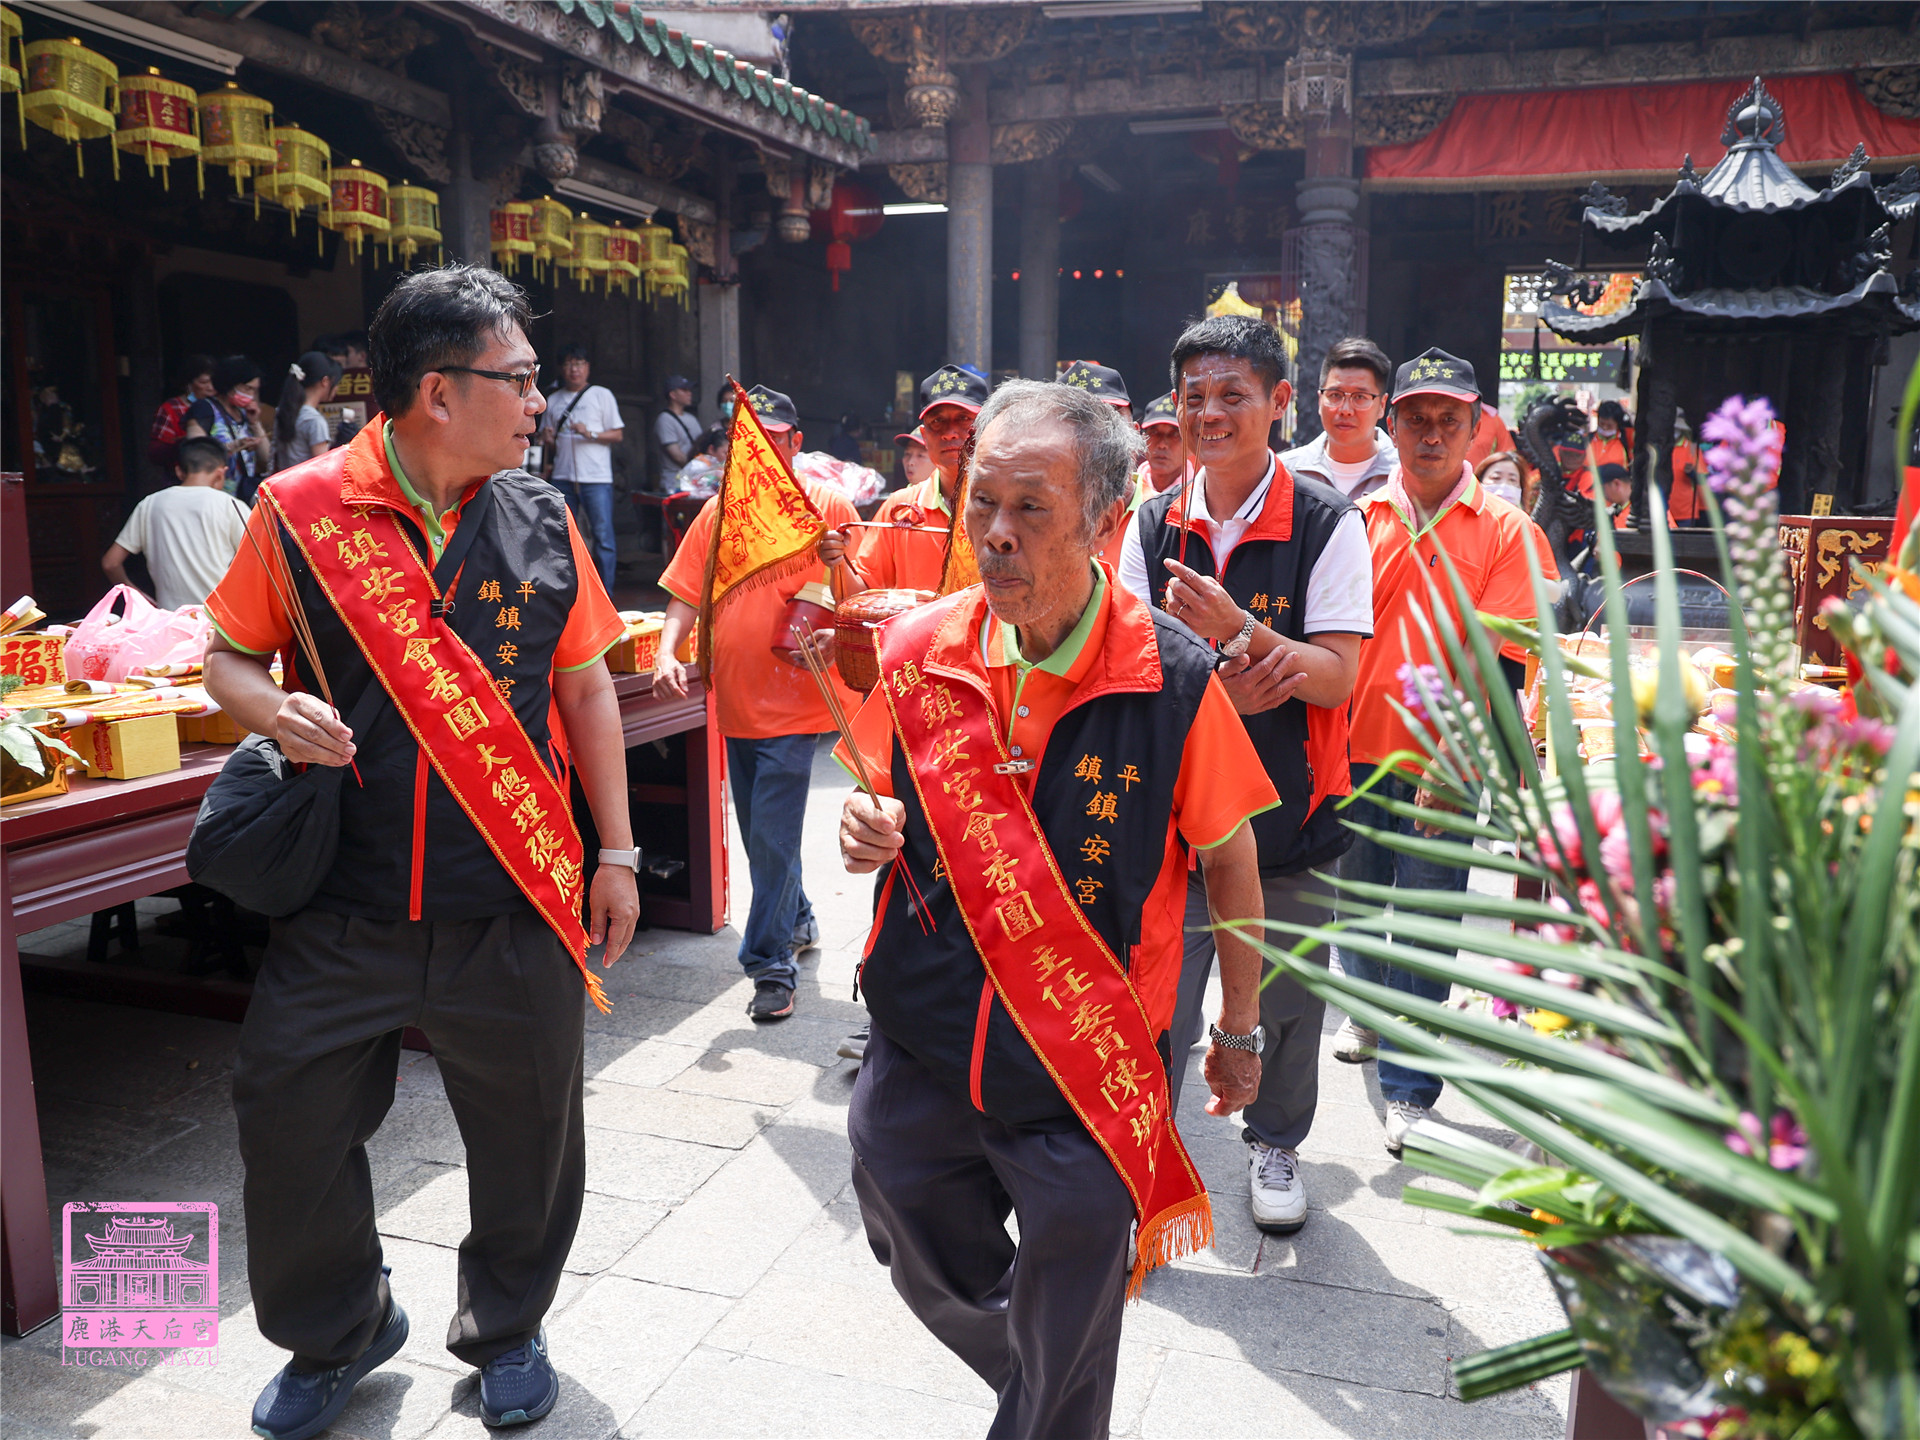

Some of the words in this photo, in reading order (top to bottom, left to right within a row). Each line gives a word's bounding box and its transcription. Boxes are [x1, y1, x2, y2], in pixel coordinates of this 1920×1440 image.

[161, 95, 176, 126] 天后宮
[931, 381, 968, 395] 鎮安宮
[1409, 367, 1455, 381] 鎮安宮
[0, 640, 47, 686] 福
[44, 638, 65, 683] 財子壽
[494, 606, 522, 699] 鎮安宮
[337, 527, 490, 742] 鎮安宮會香團
[475, 742, 584, 926] 大總理張應
[1075, 790, 1120, 904] 鎮安宮
[920, 682, 1044, 942] 鎮安宮會香團
[1031, 943, 1160, 1173] 主任委員陳墩
